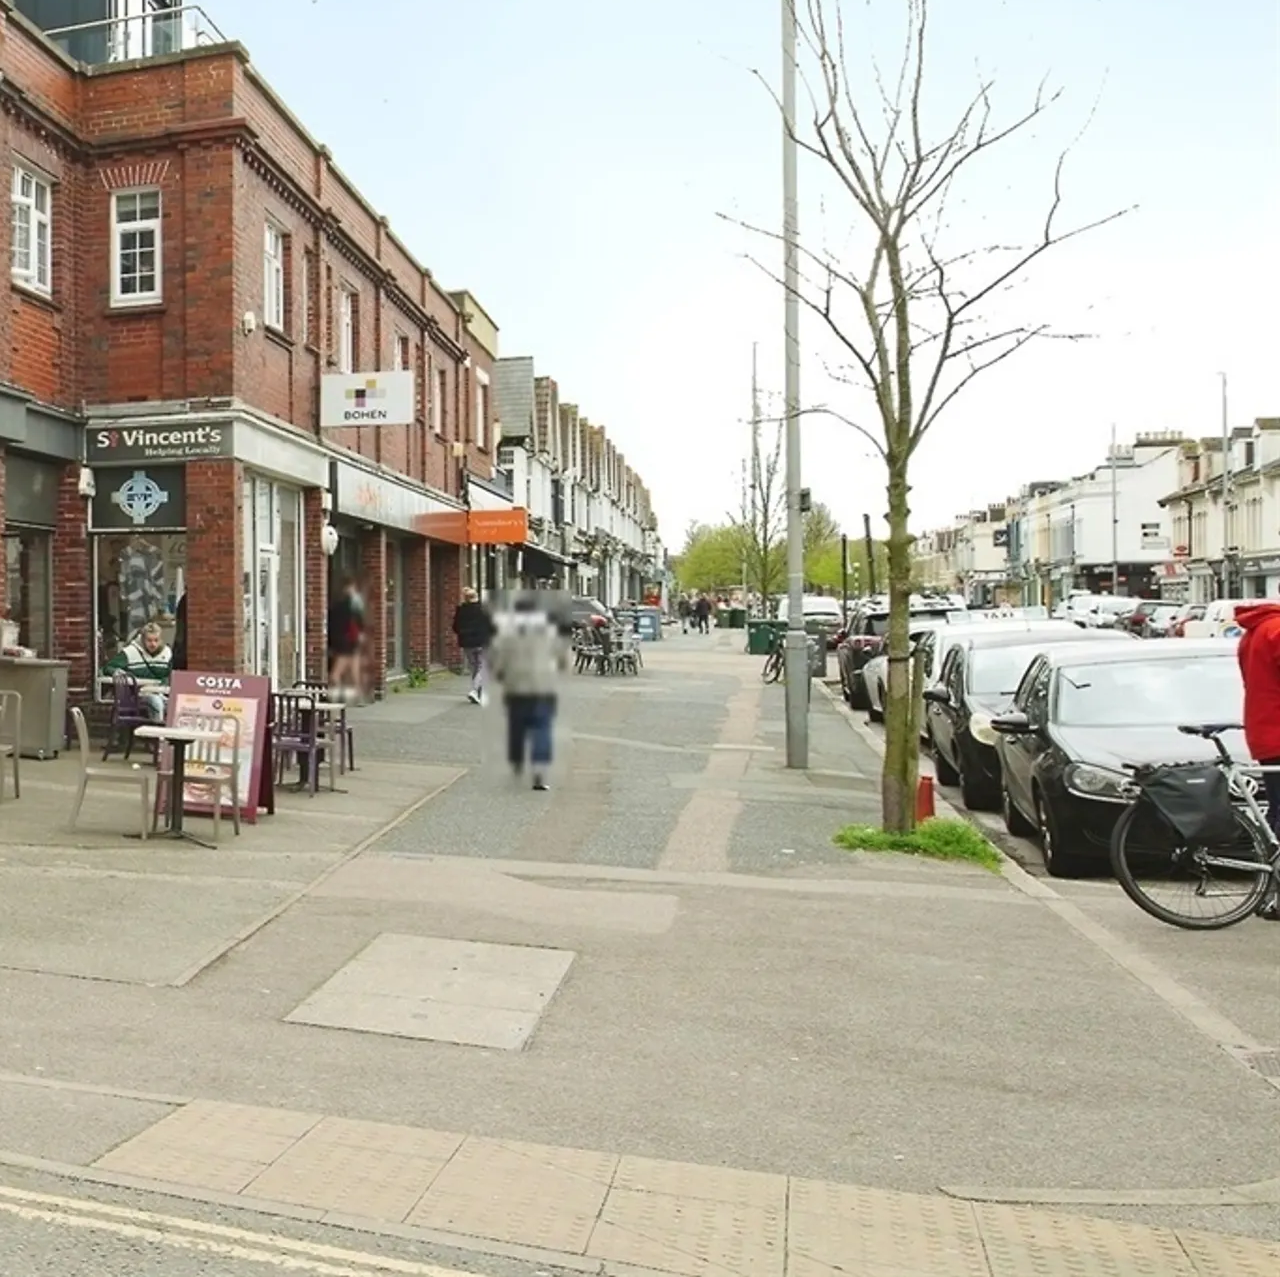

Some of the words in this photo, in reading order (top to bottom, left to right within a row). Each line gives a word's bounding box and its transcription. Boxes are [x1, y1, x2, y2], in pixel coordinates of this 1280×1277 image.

[344, 410, 387, 420] BOHEN
[122, 425, 222, 446] Vincent's
[145, 446, 184, 457] Helping
[196, 676, 242, 689] COSTA
